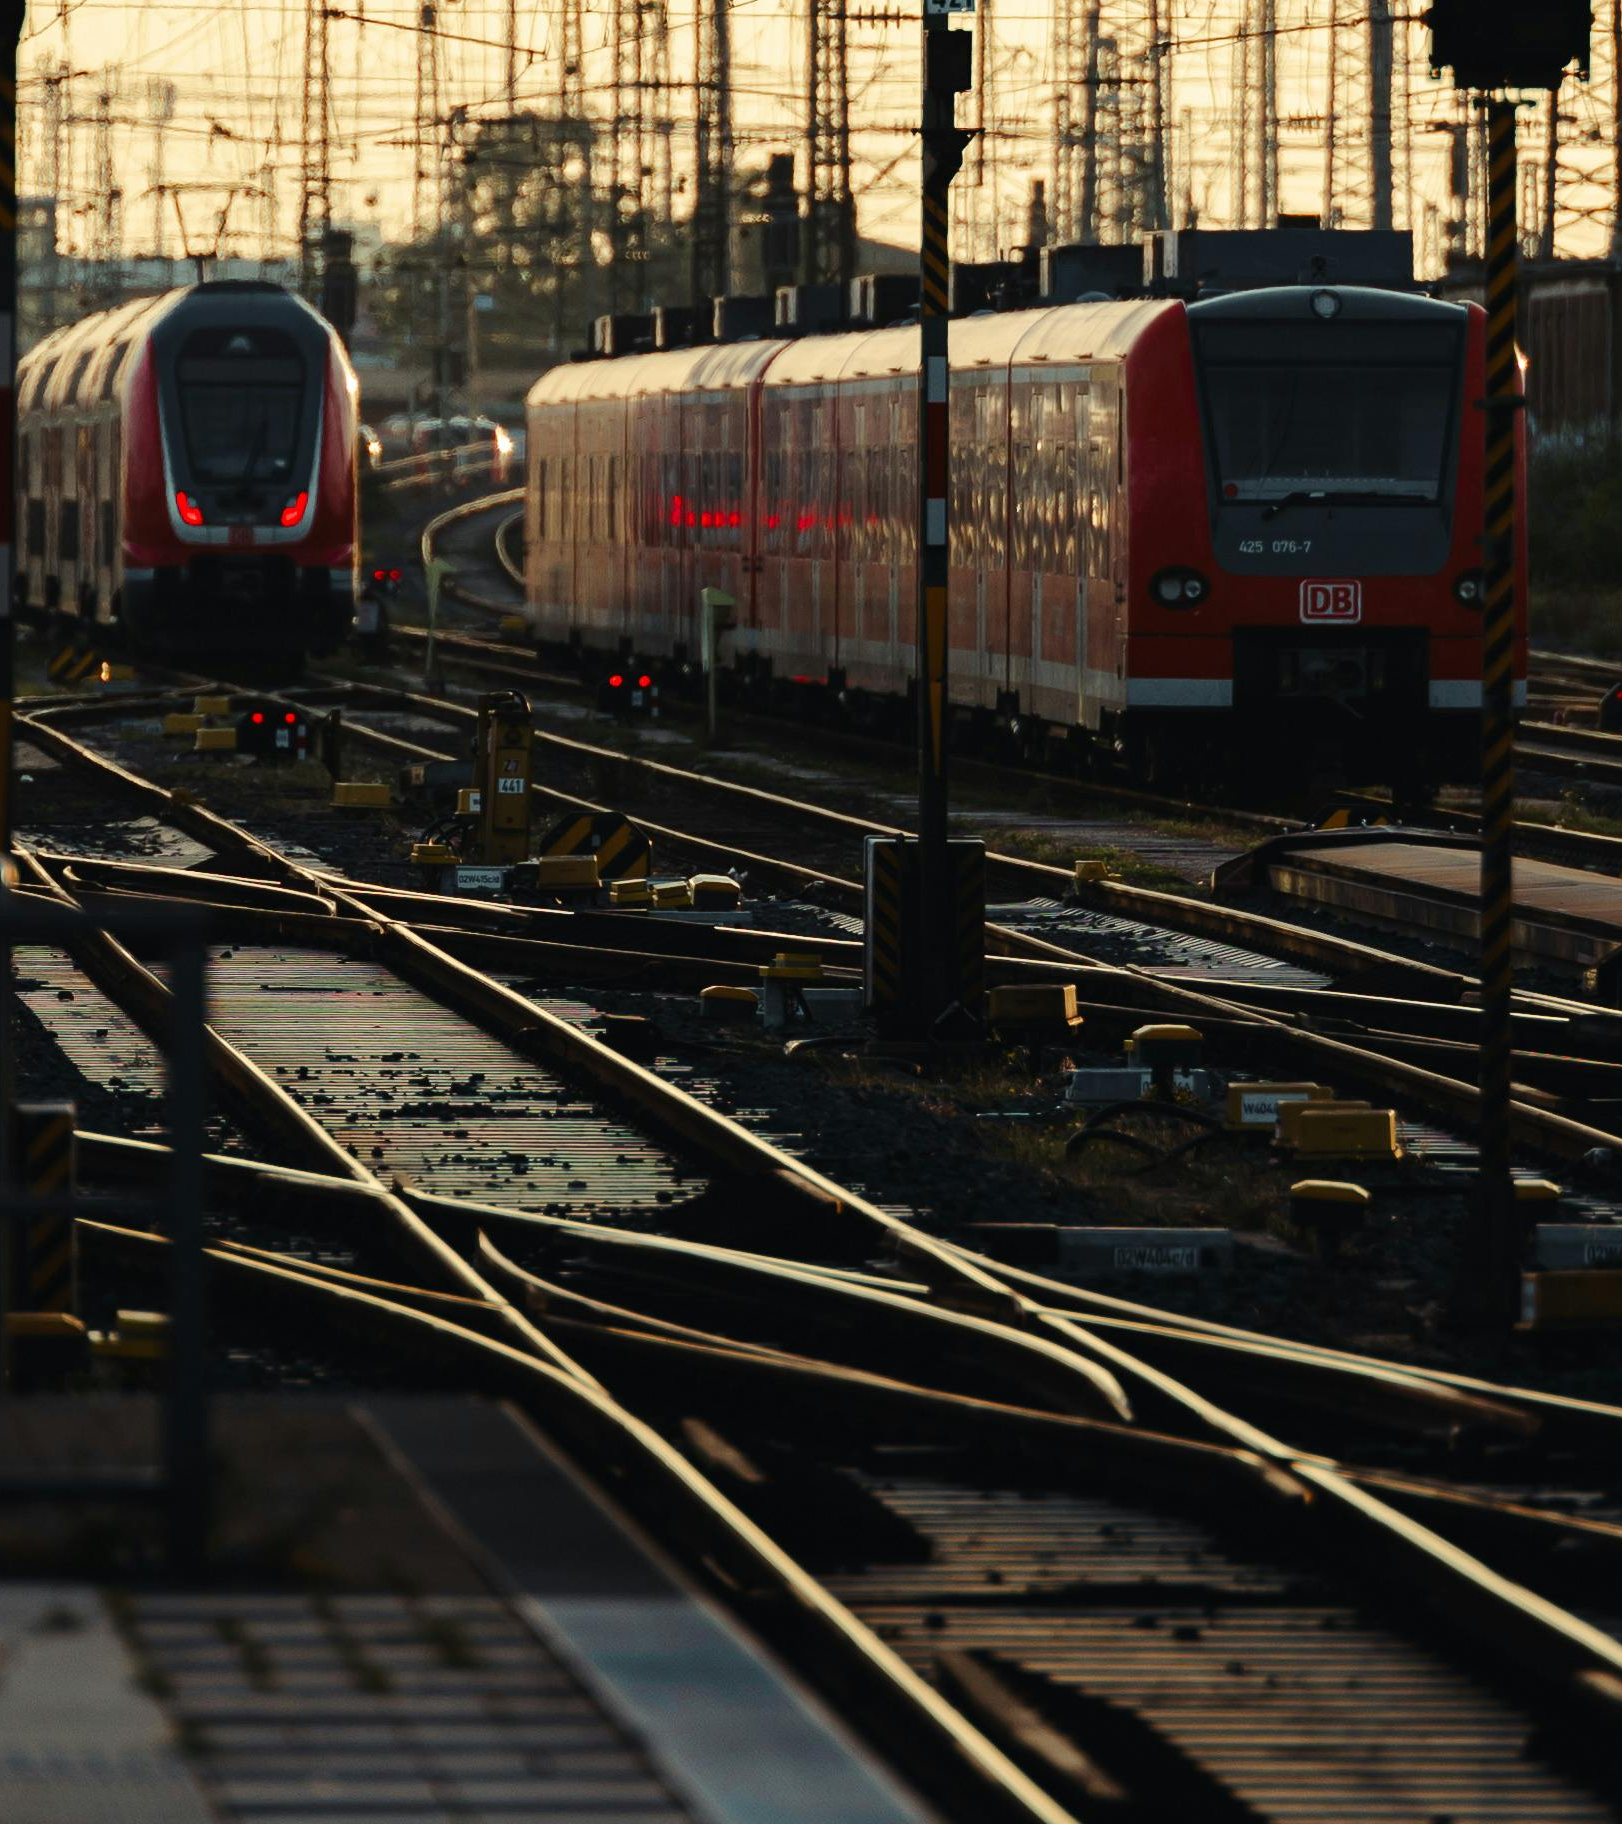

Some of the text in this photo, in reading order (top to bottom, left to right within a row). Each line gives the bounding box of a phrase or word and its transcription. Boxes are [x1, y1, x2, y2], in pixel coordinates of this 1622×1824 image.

[1239, 540, 1312, 553] 425 076-7
[1309, 586, 1353, 614] DB
[501, 778, 522, 793] 441
